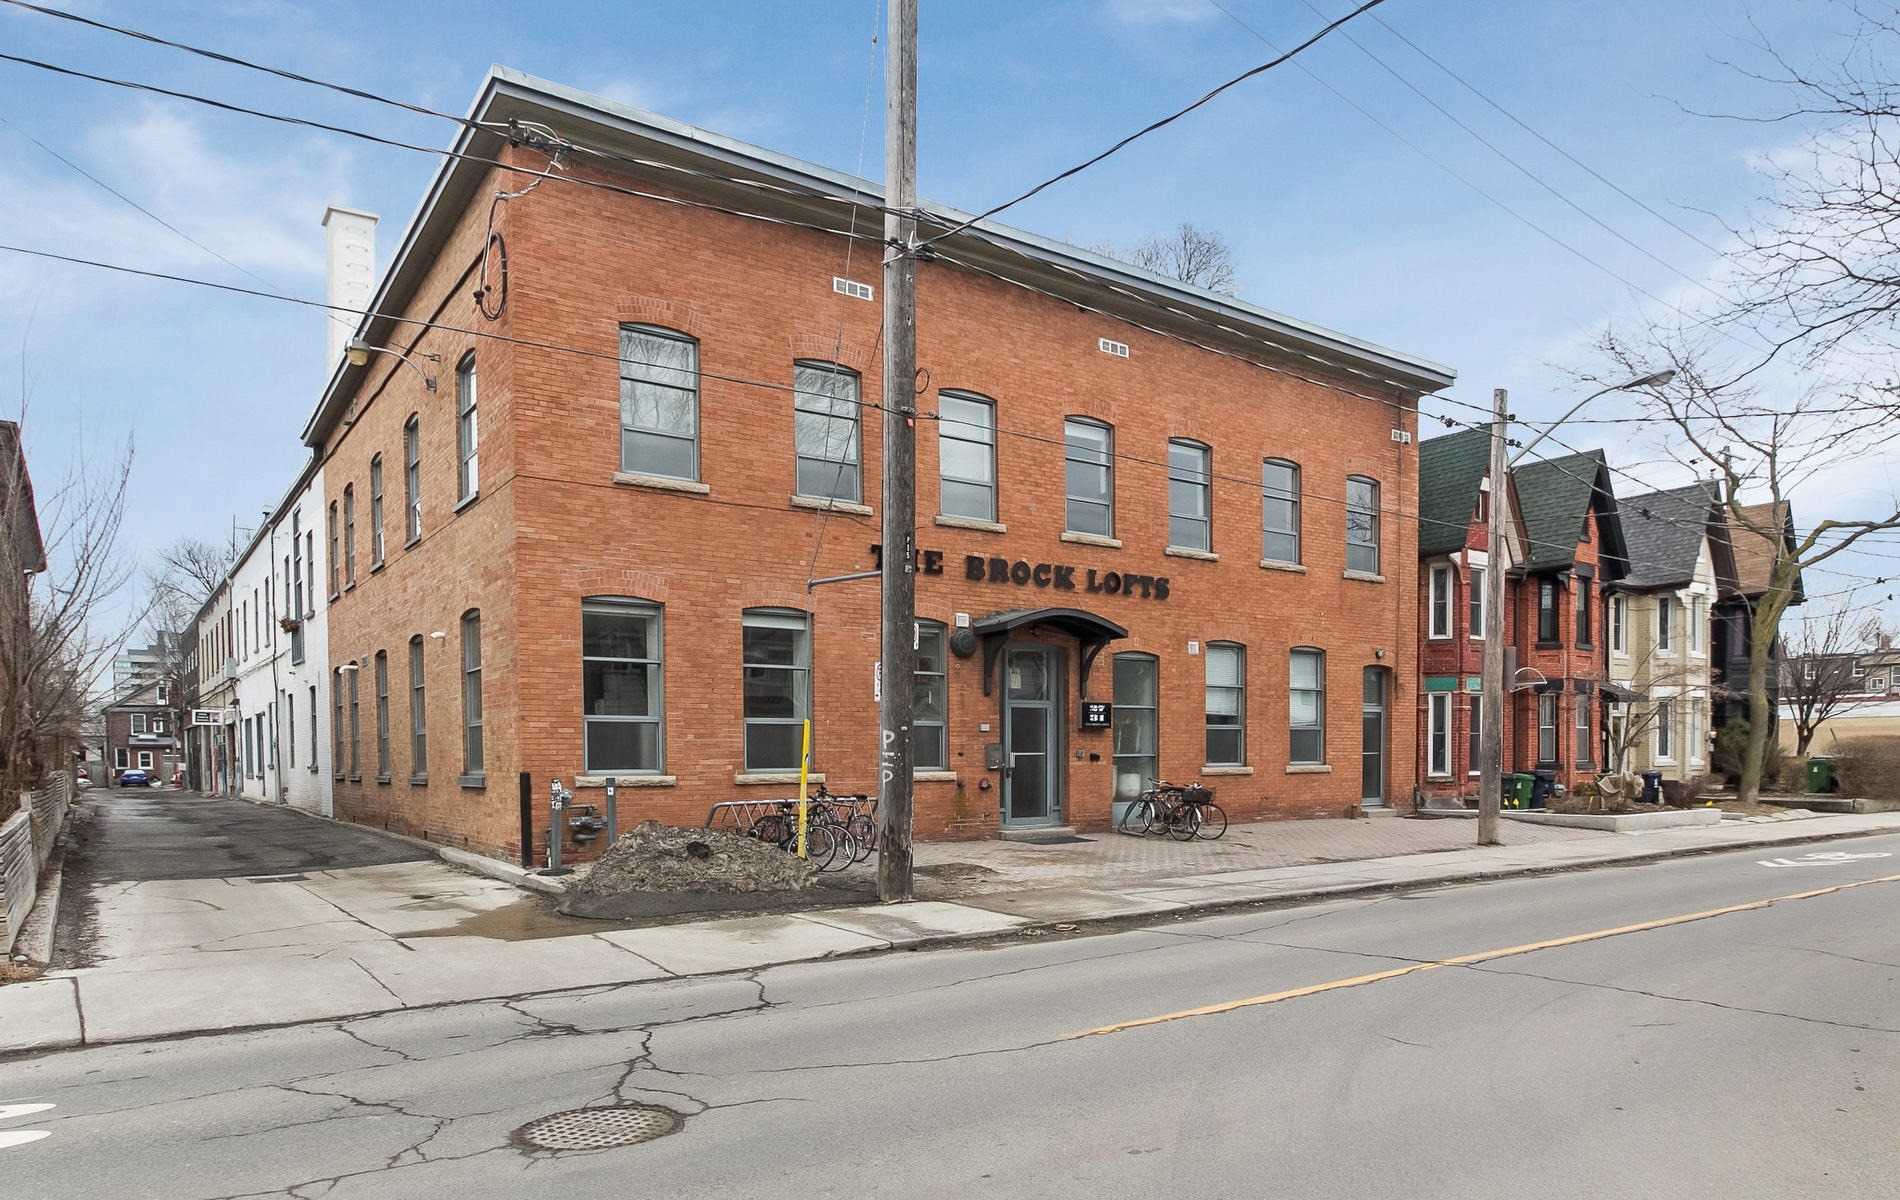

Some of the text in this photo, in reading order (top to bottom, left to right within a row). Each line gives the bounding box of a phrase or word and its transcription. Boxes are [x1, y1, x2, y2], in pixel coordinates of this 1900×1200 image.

[870, 543, 1170, 600] TE BROCK LOFTS
